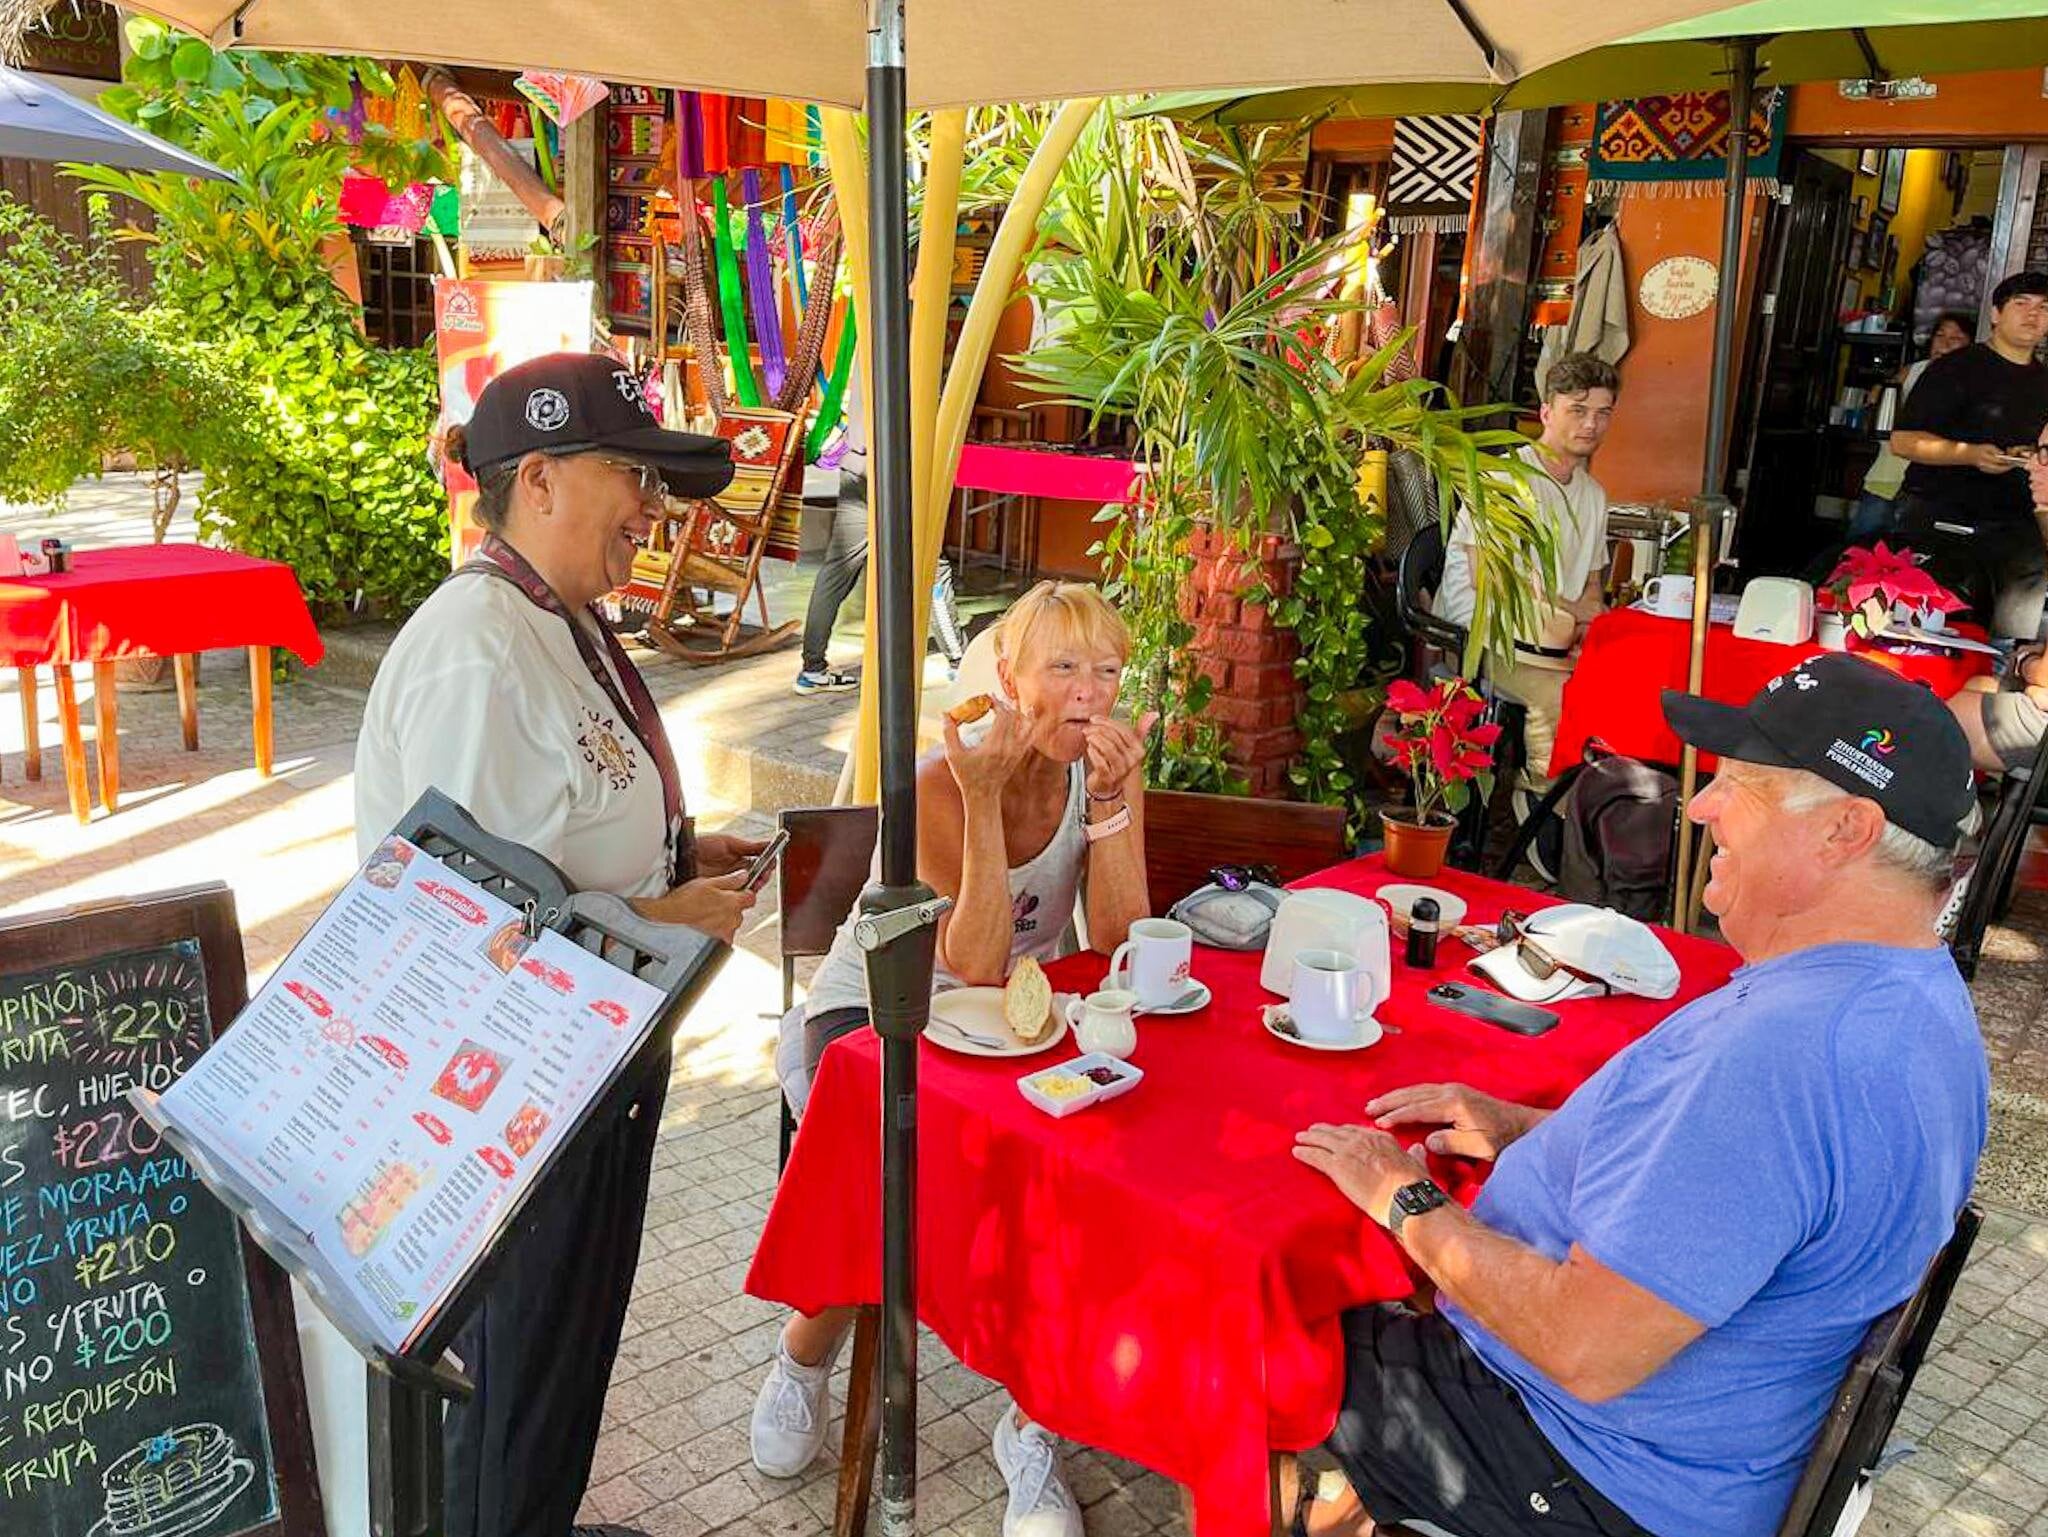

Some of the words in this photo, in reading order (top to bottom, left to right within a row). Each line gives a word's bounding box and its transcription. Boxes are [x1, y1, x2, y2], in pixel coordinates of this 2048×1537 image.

[93, 999, 188, 1047] $220
[53, 1112, 161, 1168] $220
[65, 1202, 151, 1255] FRUTA
[73, 1311, 172, 1369] $200
[23, 1356, 177, 1437] REQUESÓN
